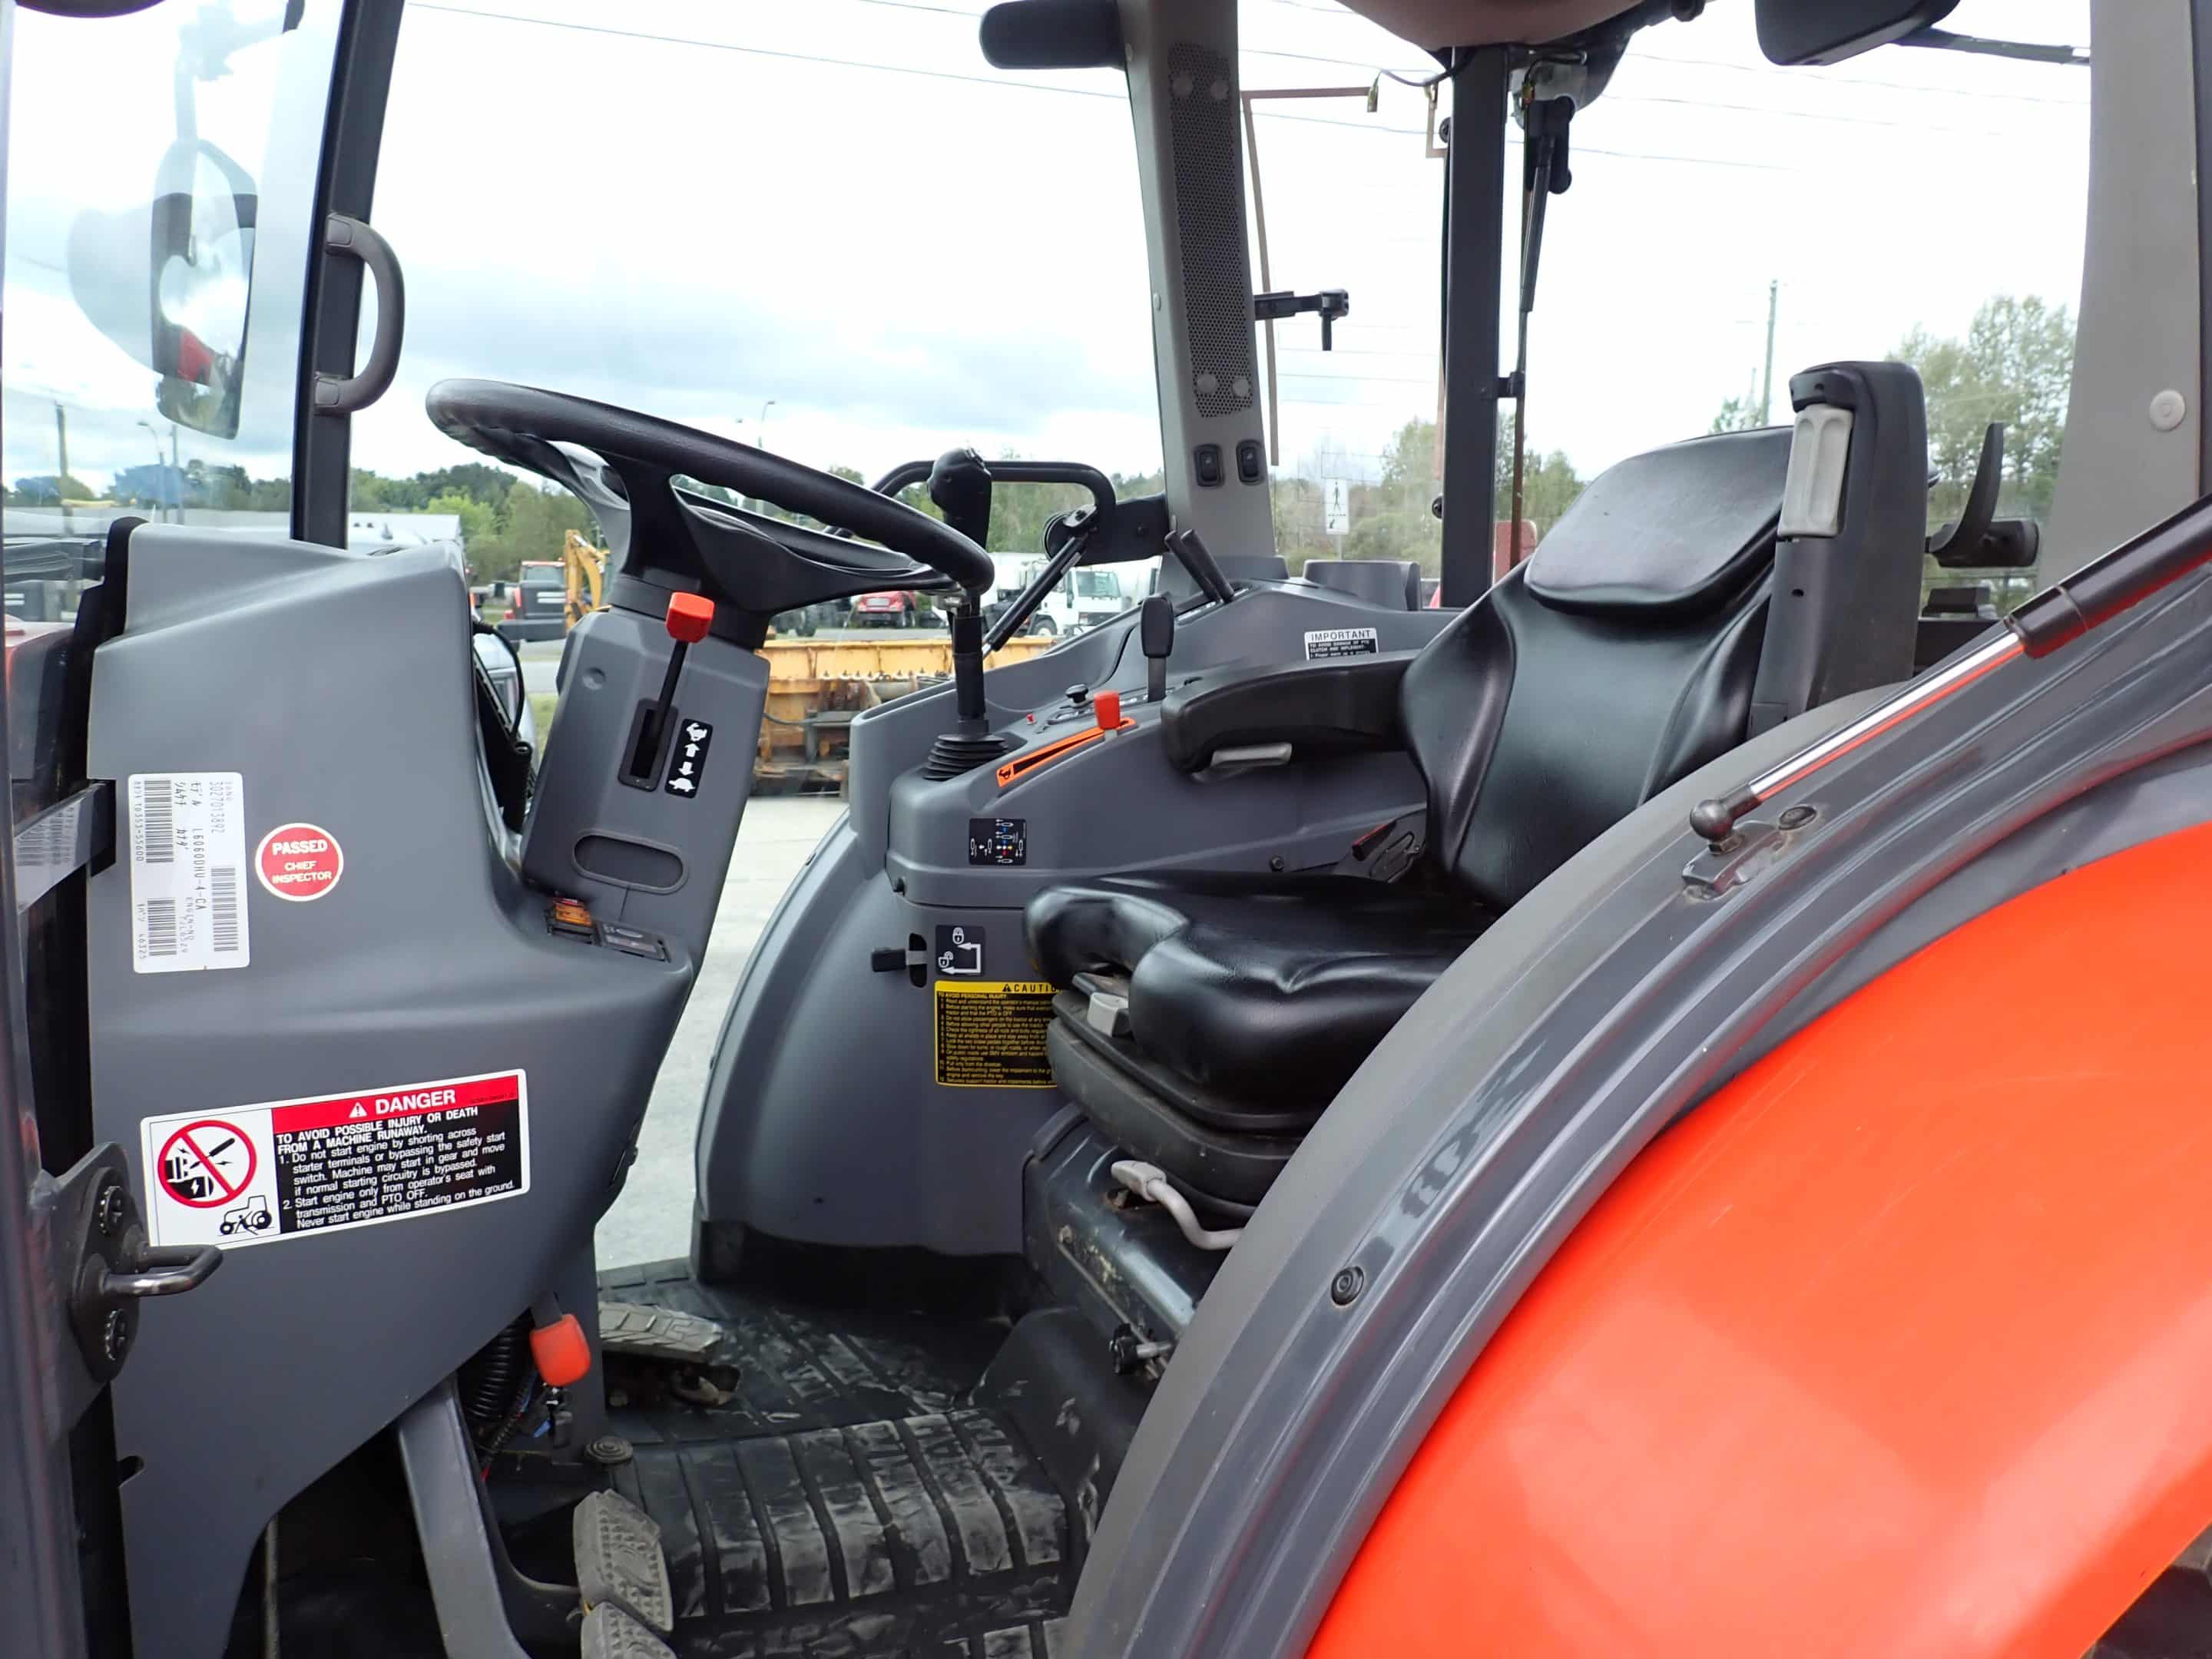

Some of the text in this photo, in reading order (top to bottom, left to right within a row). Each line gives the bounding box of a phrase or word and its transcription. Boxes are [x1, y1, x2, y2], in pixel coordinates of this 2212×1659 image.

[1311, 630, 1371, 641] IMPORTANT
[272, 839, 328, 856] PASSED
[192, 828, 208, 910] L6060DHU-4-CA
[272, 871, 333, 884] INSPECTOR
[284, 860, 317, 871] CHIEF
[1014, 984, 1057, 993] CAUTIO
[375, 1089, 455, 1114] DANGER
[276, 1106, 478, 1144] TO AVOID POSSIBLE INJURY OR DEATH
[278, 1124, 428, 1154] FROM A MACHINE RUNAWAY.
[280, 1128, 477, 1164] 1. Do not start engine by shorting across
[293, 1131, 505, 1174] starter terminals or bypassing the safety start
[293, 1144, 505, 1185] switch. Machine may start in gear and move
[294, 1159, 476, 1196] if normal starting circuitry is bypassed.
[283, 1165, 496, 1210] 2. Start engine only from operator's seat with
[296, 1188, 428, 1219] transmission and PTO OFF.
[296, 1180, 515, 1229] Never start engine while standing on the ground.
